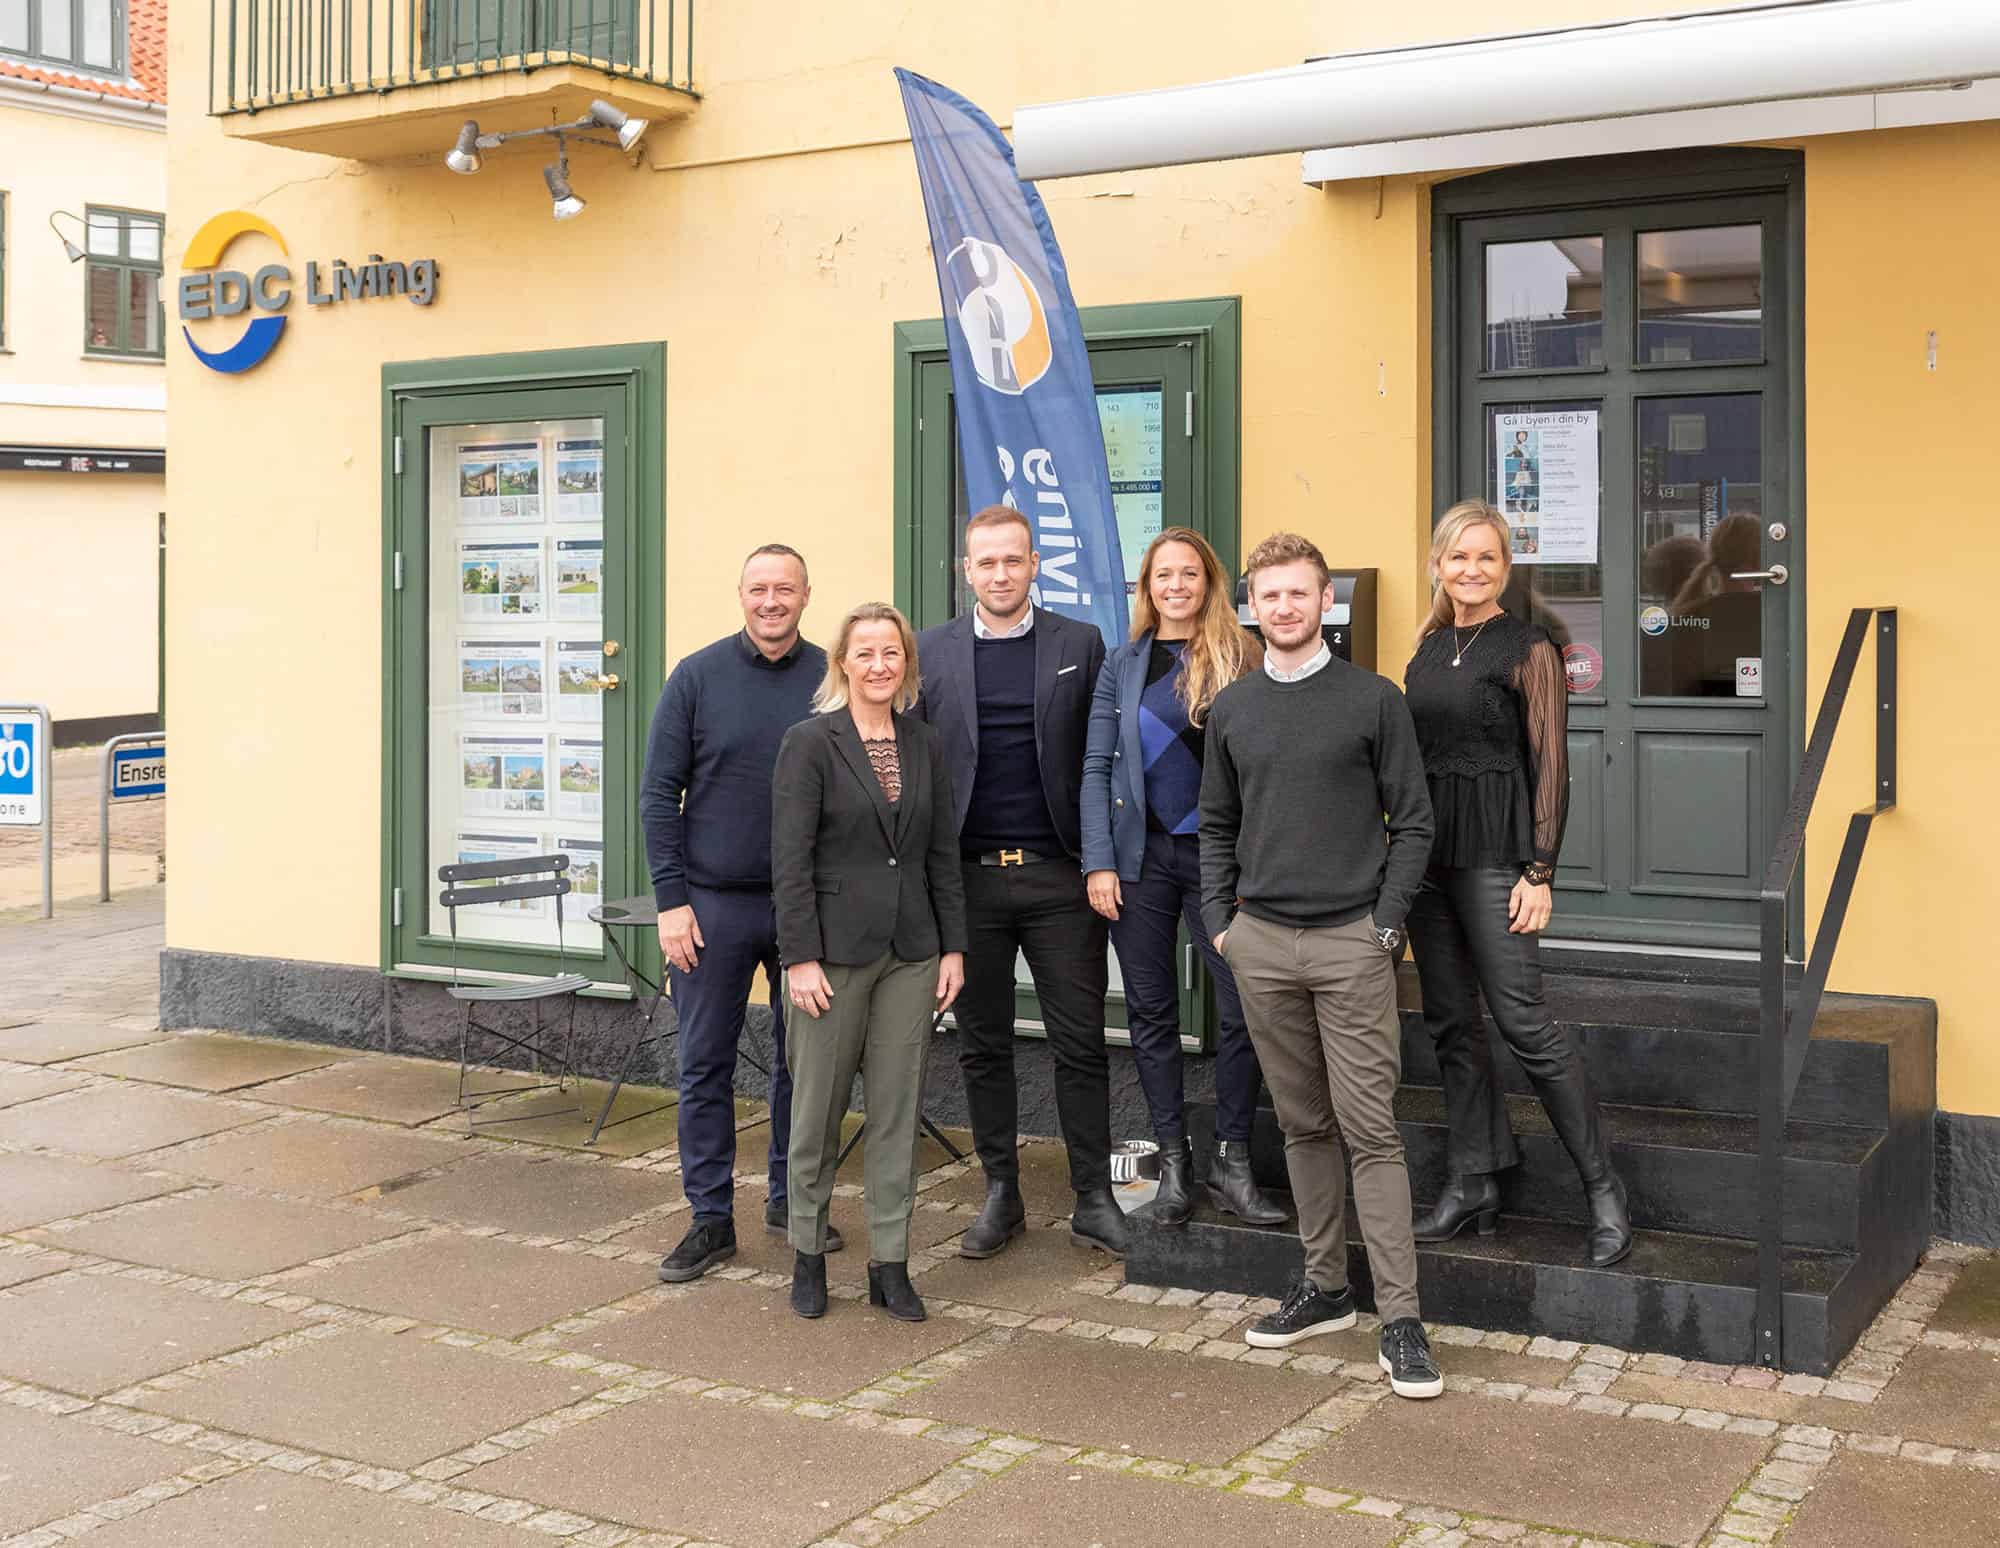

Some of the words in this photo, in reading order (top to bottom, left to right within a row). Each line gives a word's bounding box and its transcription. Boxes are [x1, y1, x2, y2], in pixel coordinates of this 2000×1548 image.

[179, 264, 291, 320] EDC
[306, 254, 440, 305] Living
[1526, 414, 1550, 427] byen
[1558, 413, 1574, 424] din
[1577, 412, 1590, 426] by
[1671, 616, 1710, 630] Living
[1333, 632, 1342, 644] 2
